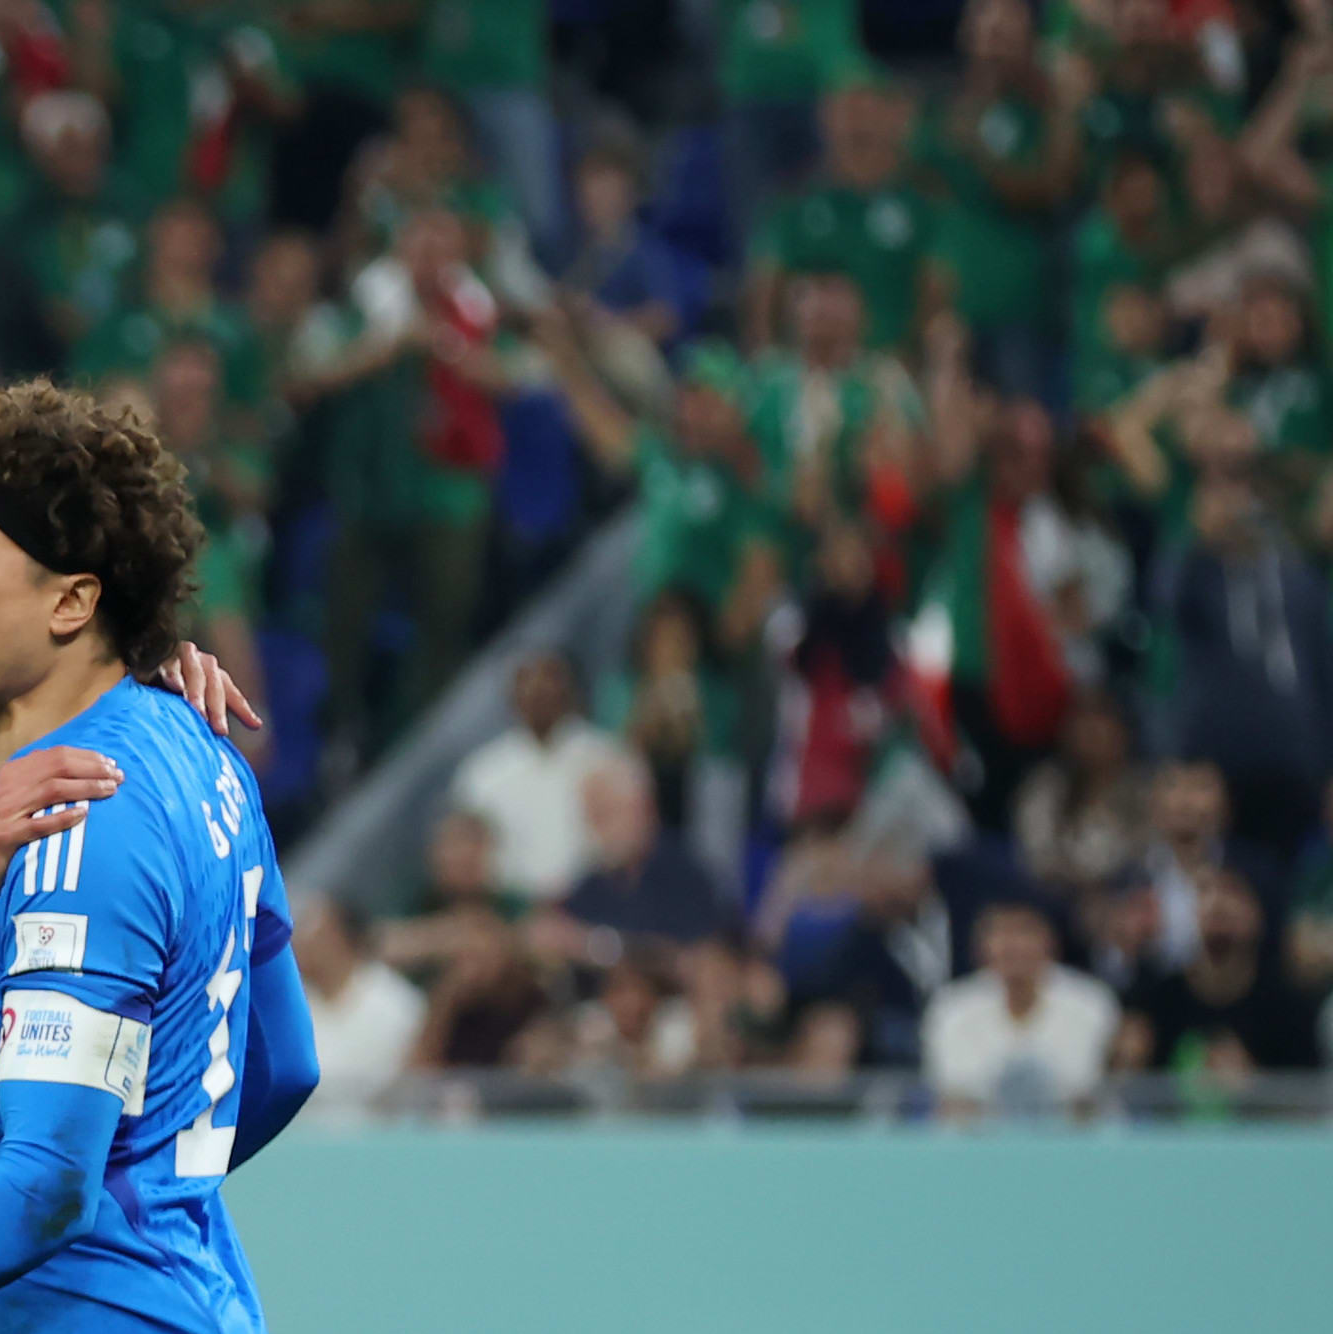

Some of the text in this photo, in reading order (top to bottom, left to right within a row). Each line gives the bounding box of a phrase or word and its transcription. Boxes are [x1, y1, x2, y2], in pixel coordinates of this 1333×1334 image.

[23, 1008, 73, 1024] FOOTBALL
[20, 1022, 73, 1042] UNITES
[34, 1044, 71, 1059] World
